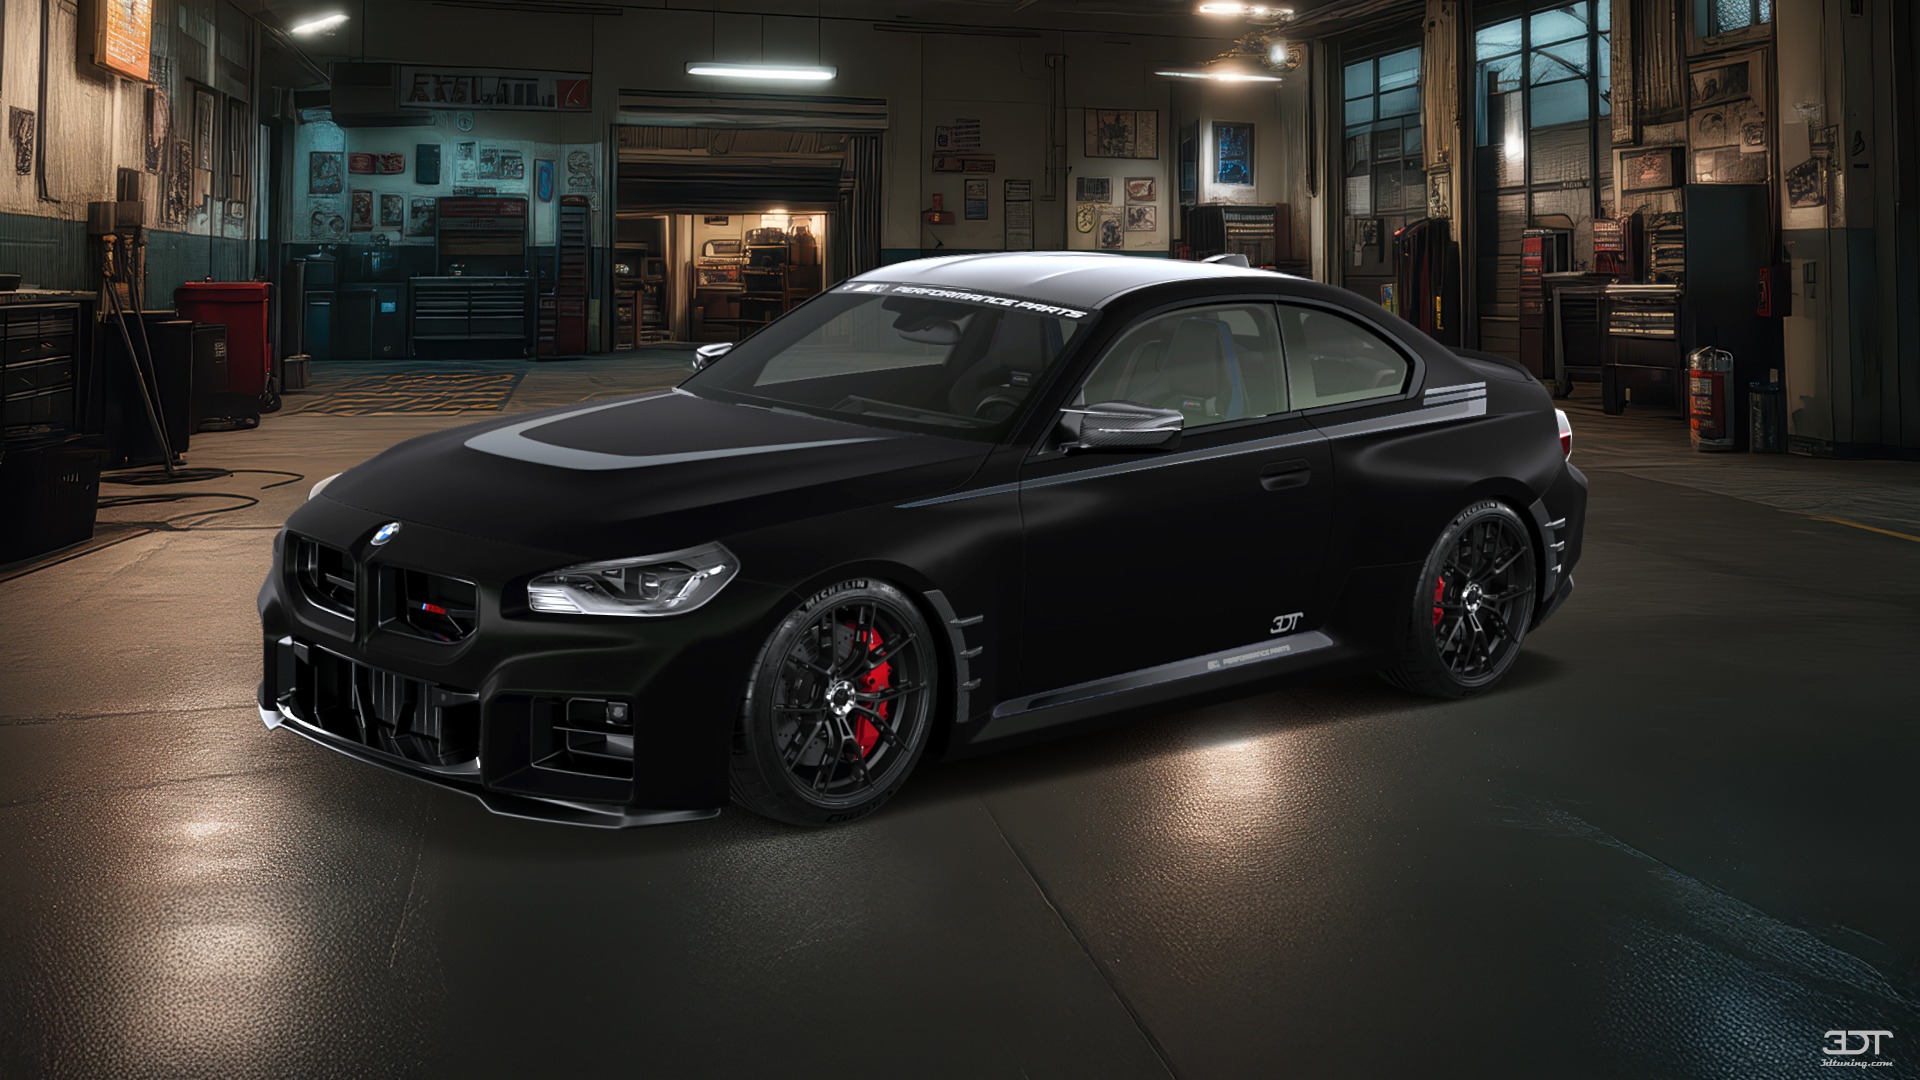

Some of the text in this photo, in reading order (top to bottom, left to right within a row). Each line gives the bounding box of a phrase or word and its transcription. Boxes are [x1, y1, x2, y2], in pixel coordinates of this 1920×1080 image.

[892, 286, 1018, 307] PERFORMANCE
[1015, 300, 1088, 319] PARTS
[805, 580, 865, 610] MICHELIN
